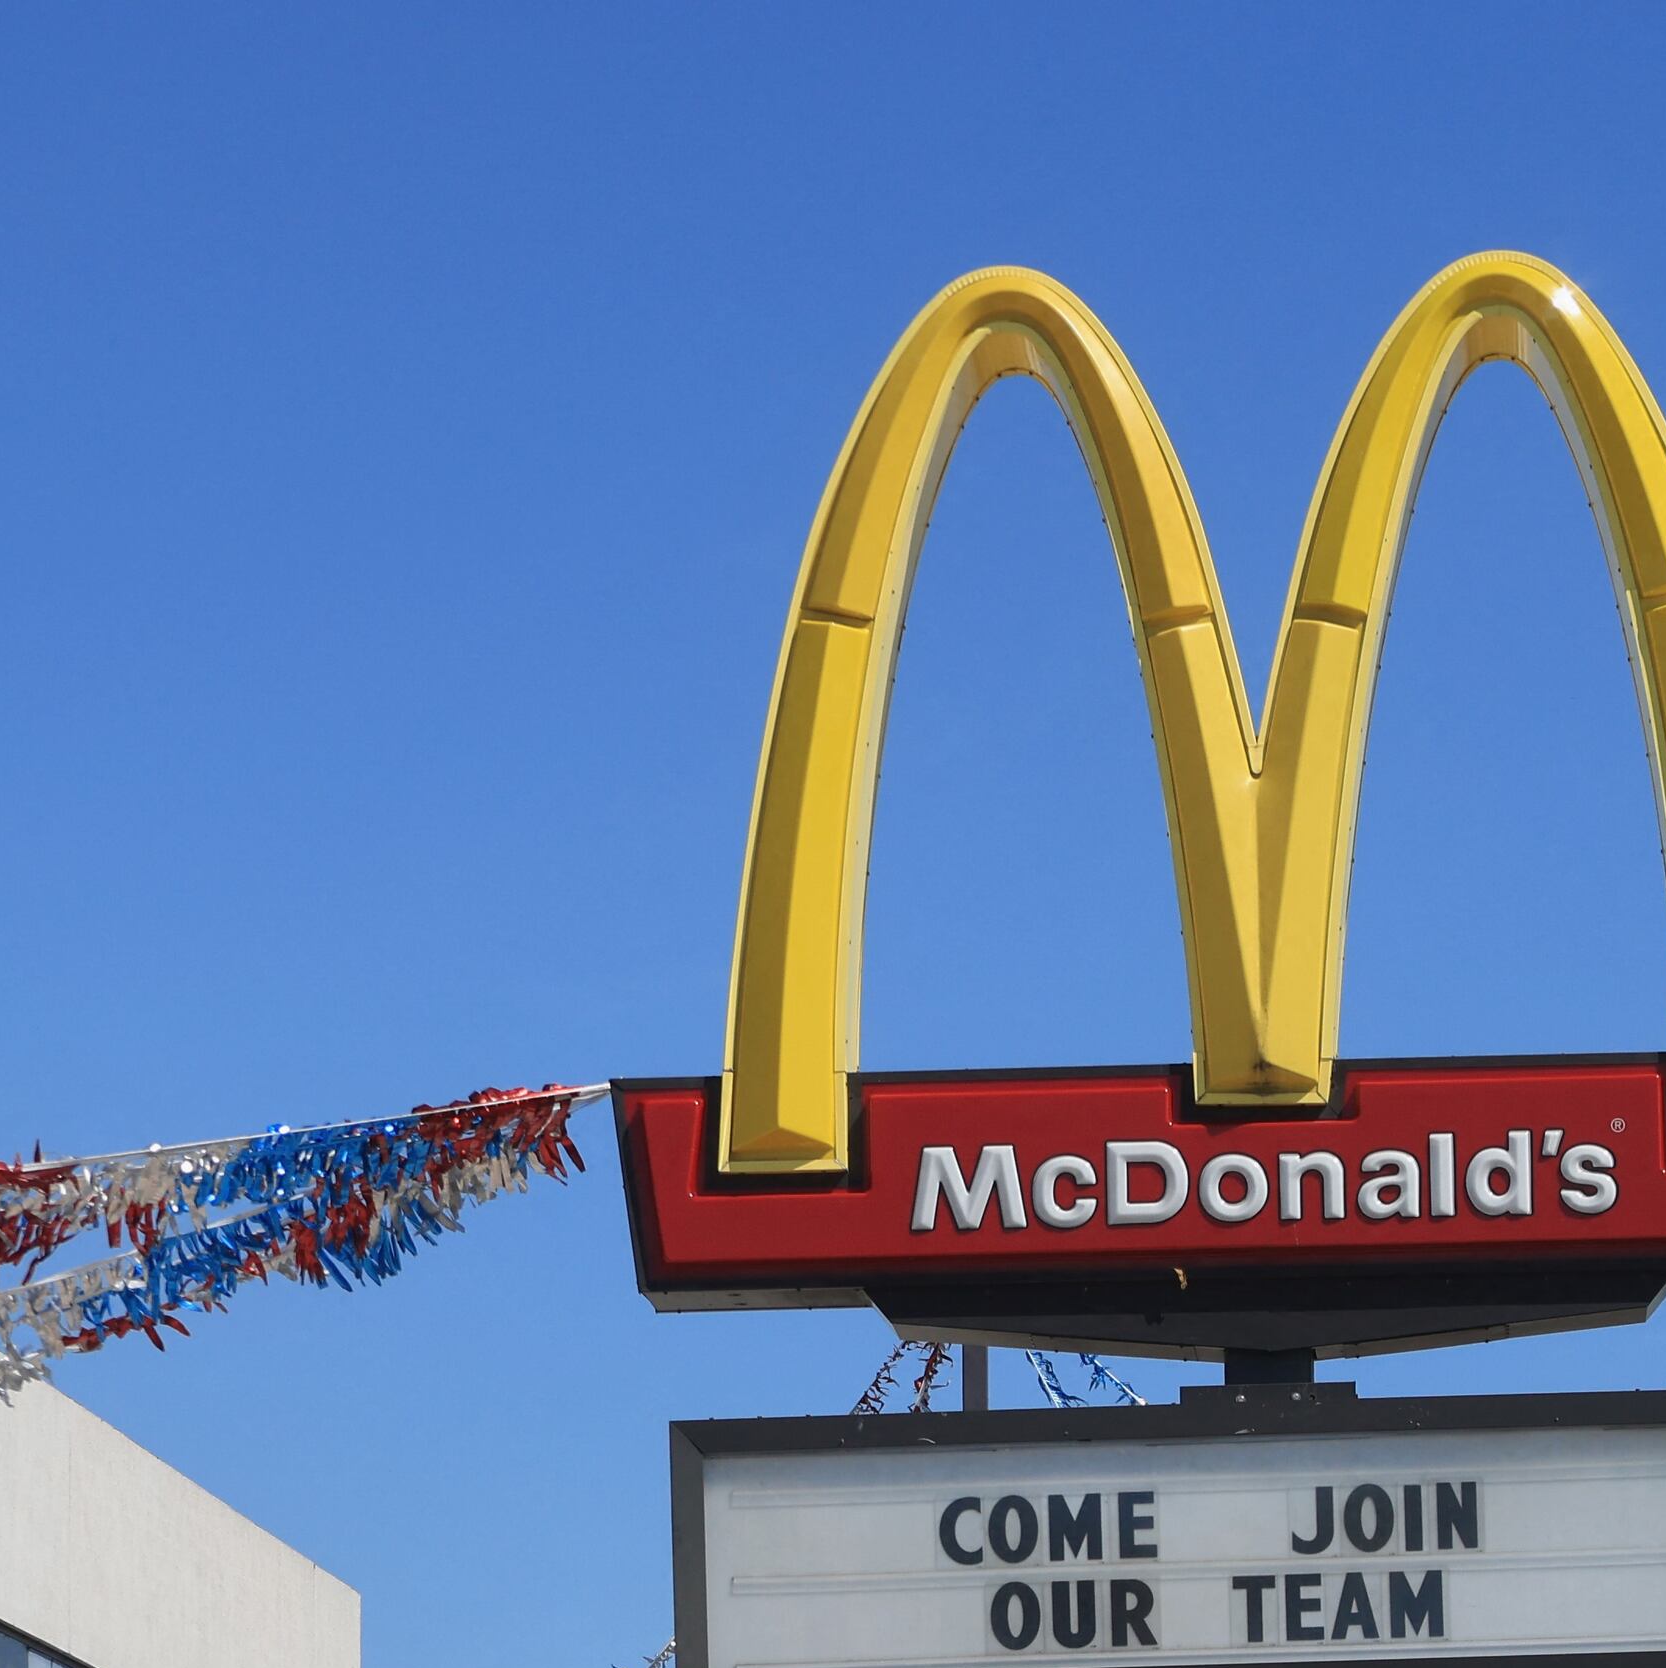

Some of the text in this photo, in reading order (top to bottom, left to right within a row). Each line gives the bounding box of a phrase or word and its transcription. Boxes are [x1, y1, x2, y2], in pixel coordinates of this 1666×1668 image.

[910, 1128, 1619, 1233] McDonald's
[938, 1481, 1479, 1565] COME JOIN
[990, 1570, 1445, 1650] OUR TEAM
